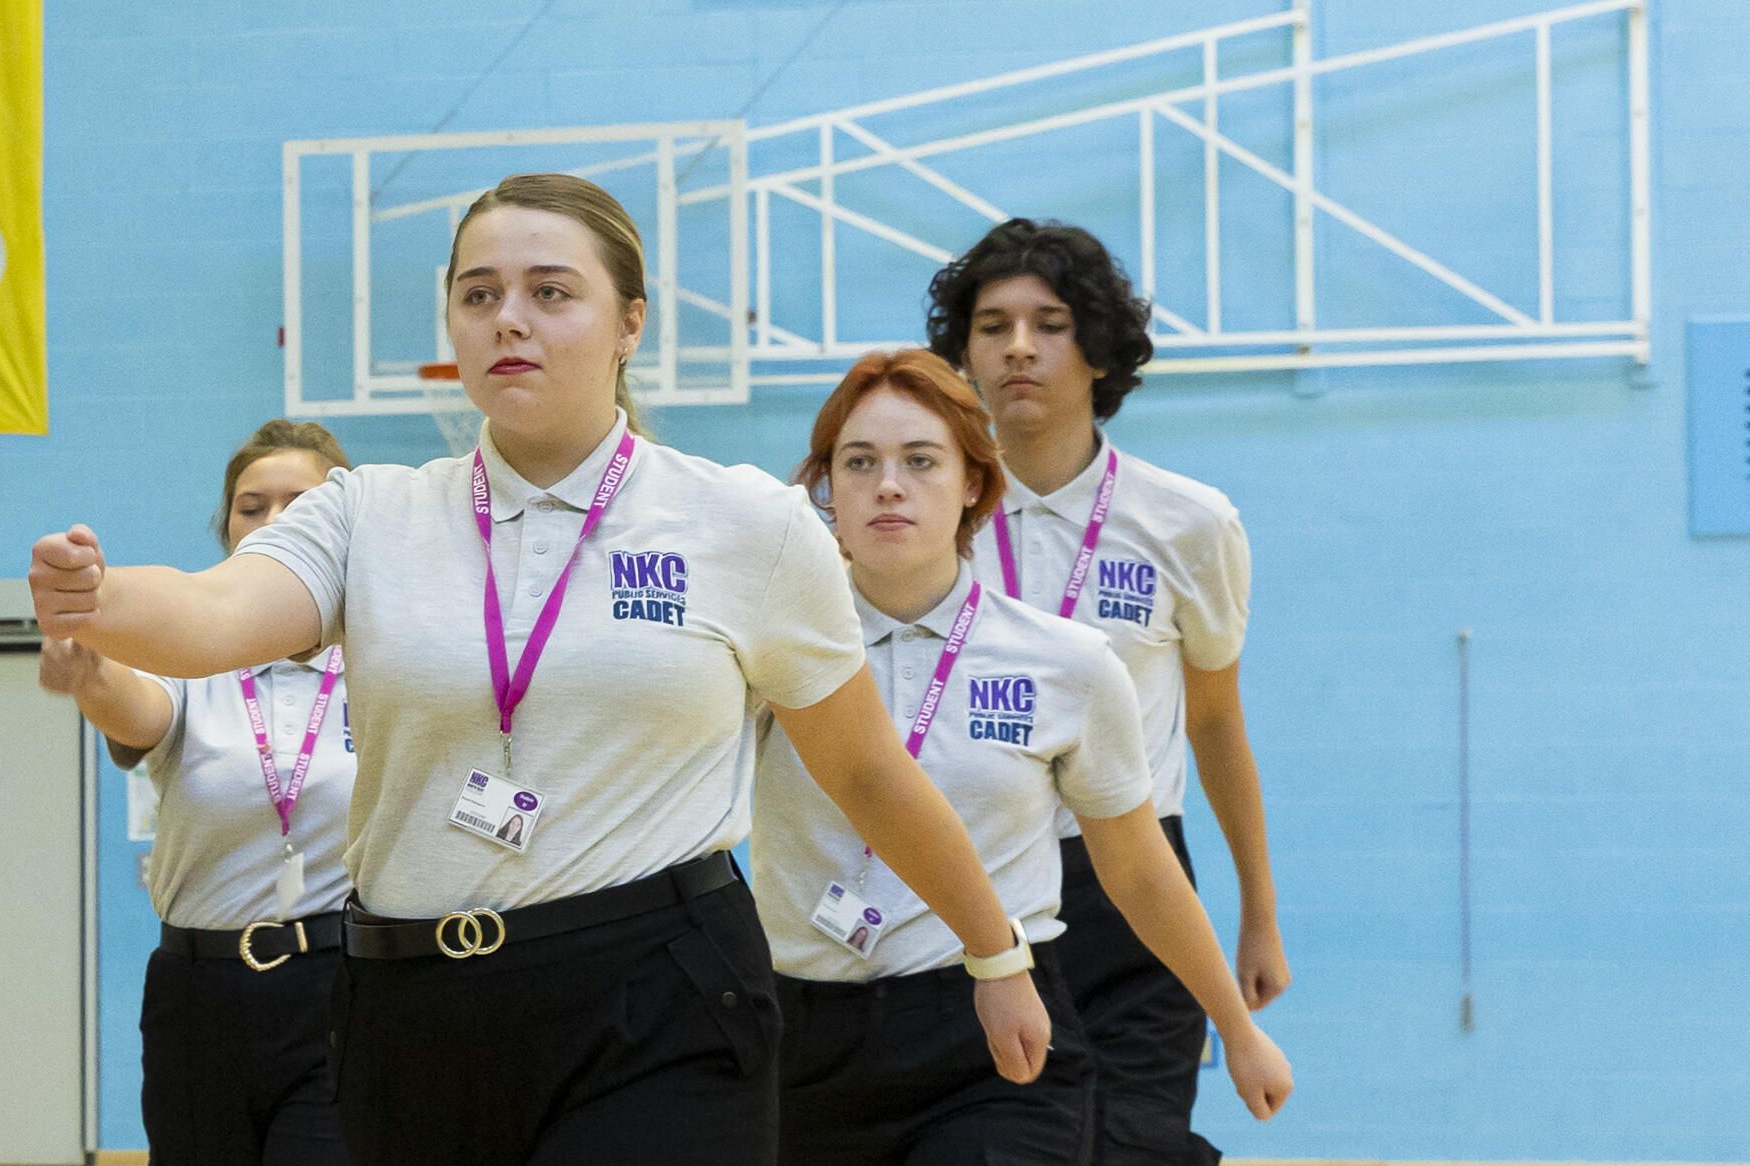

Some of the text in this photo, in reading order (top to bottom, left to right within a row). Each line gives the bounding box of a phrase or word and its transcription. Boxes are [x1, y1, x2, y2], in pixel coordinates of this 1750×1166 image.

[473, 463, 489, 514] STUDENT
[593, 453, 628, 508] STUDENT
[611, 552, 686, 593] NKC
[1066, 546, 1093, 599] STUDENT
[1100, 560, 1156, 595] NKC
[613, 600, 685, 627] CADET
[946, 602, 975, 654] STUDENT
[1098, 599, 1152, 628] CADET
[327, 644, 343, 675] DENT
[308, 693, 328, 735] STUDENT
[914, 678, 944, 735] STUDENT
[969, 677, 1035, 713] NKC
[246, 698, 265, 735] STUDENT
[969, 719, 1033, 747] CADET
[260, 753, 282, 803] STUDENT
[287, 753, 310, 800] STUDENT
